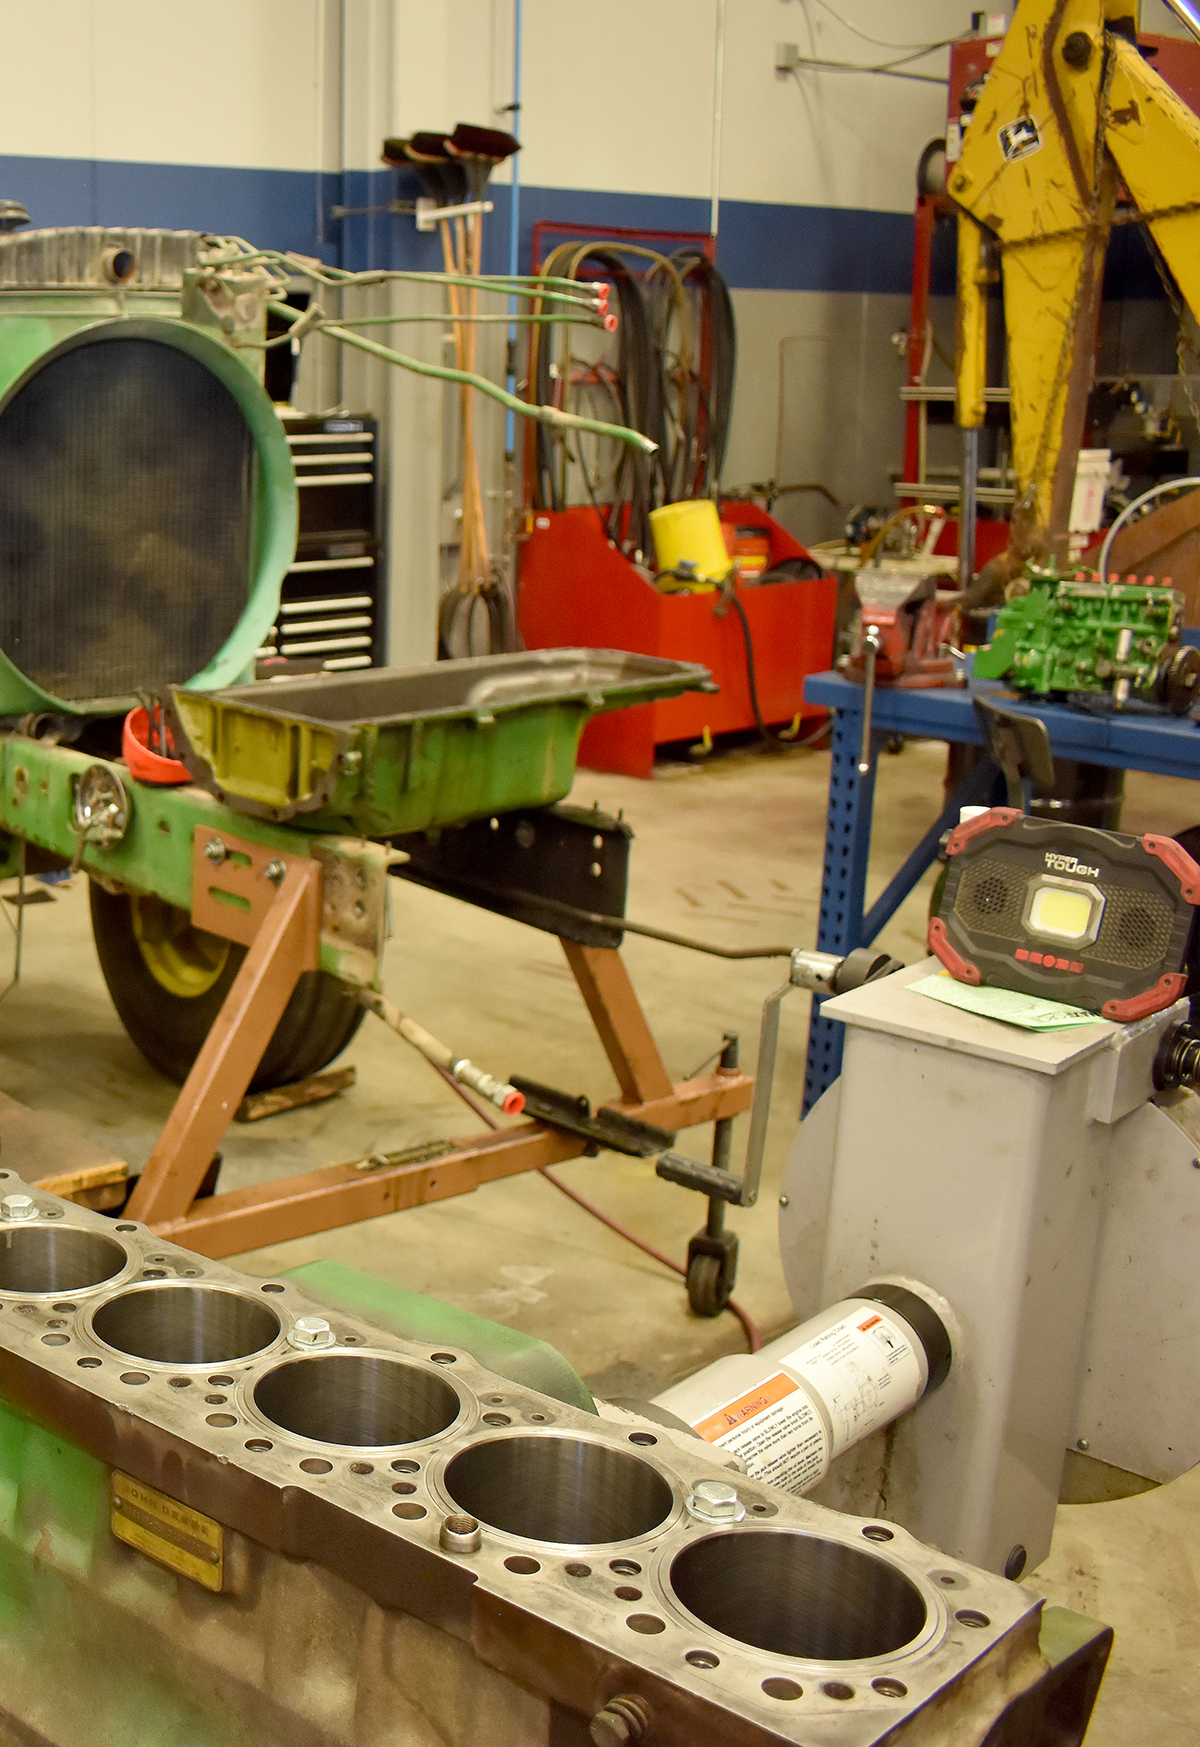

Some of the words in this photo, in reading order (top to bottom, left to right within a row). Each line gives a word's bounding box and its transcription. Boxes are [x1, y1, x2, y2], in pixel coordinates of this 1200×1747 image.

[1044, 852, 1078, 864] HYPER
[1045, 859, 1100, 878] TOUGH
[735, 1396, 769, 1420] WARNING
[124, 1484, 158, 1510] JOHN
